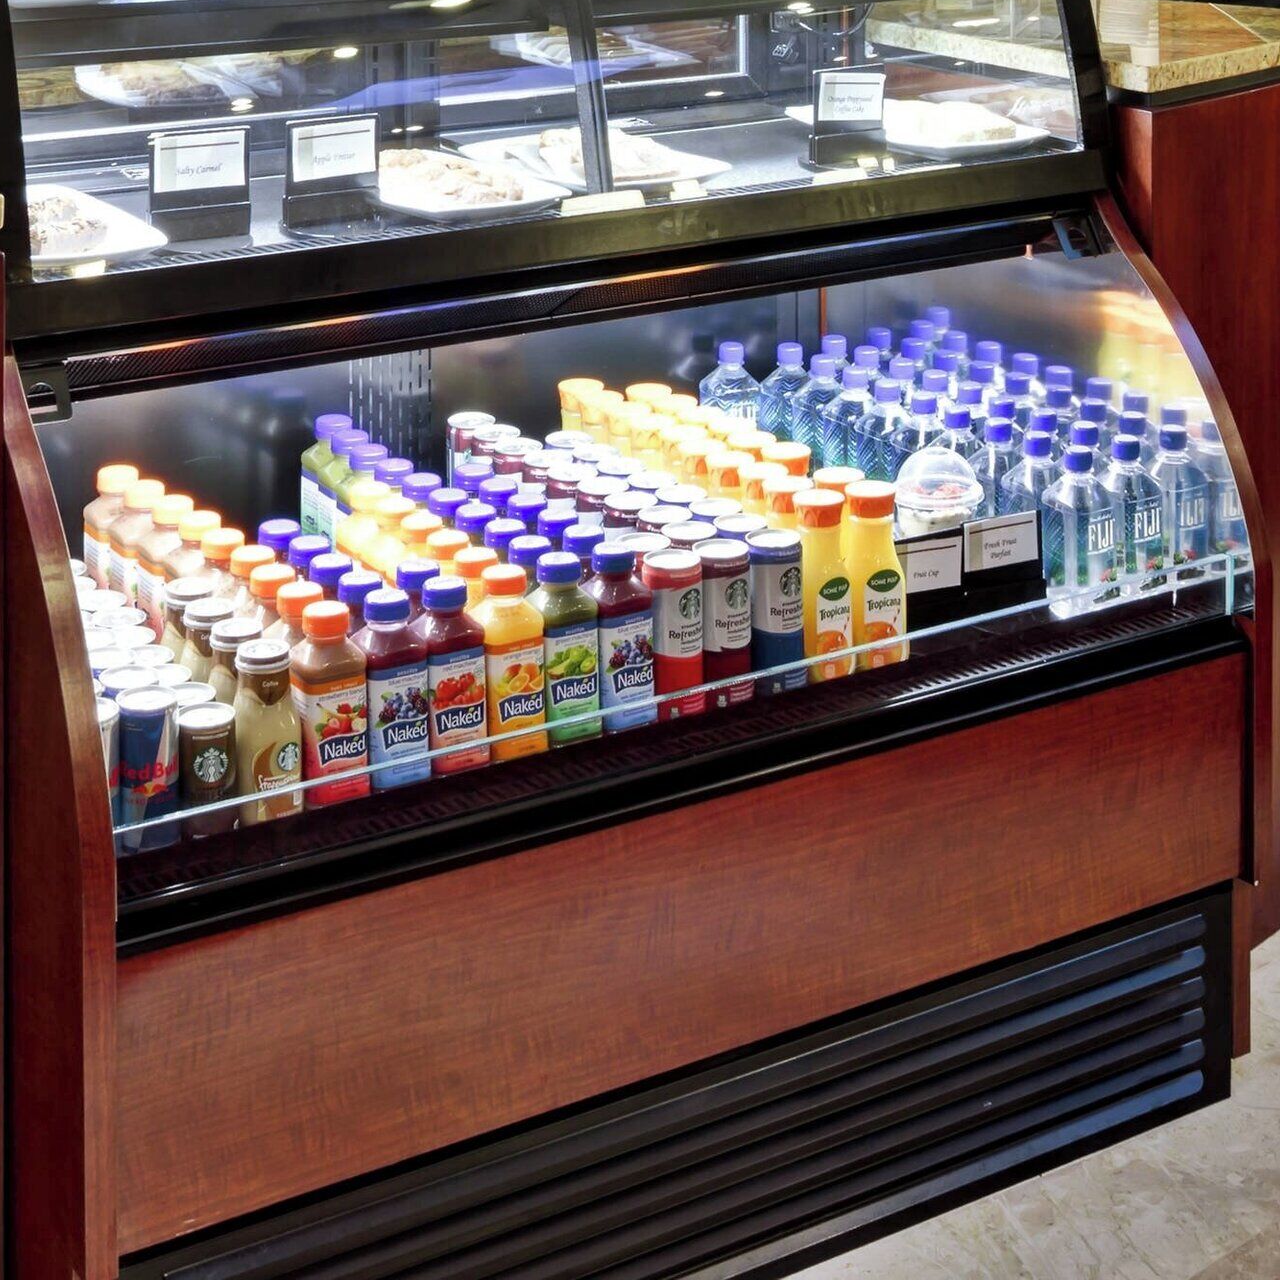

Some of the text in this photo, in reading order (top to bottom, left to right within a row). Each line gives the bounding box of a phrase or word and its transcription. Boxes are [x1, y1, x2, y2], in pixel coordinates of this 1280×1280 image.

[1088, 518, 1115, 551] FIJI
[1134, 507, 1162, 539] FIJI
[819, 606, 850, 621] Tropicana
[867, 597, 901, 611] Tropicana
[617, 665, 653, 688] Naked
[556, 678, 595, 700] Naked
[504, 694, 543, 717] Naked
[441, 707, 481, 730] Naked
[388, 721, 427, 744] Naked
[324, 735, 366, 760] Naked
